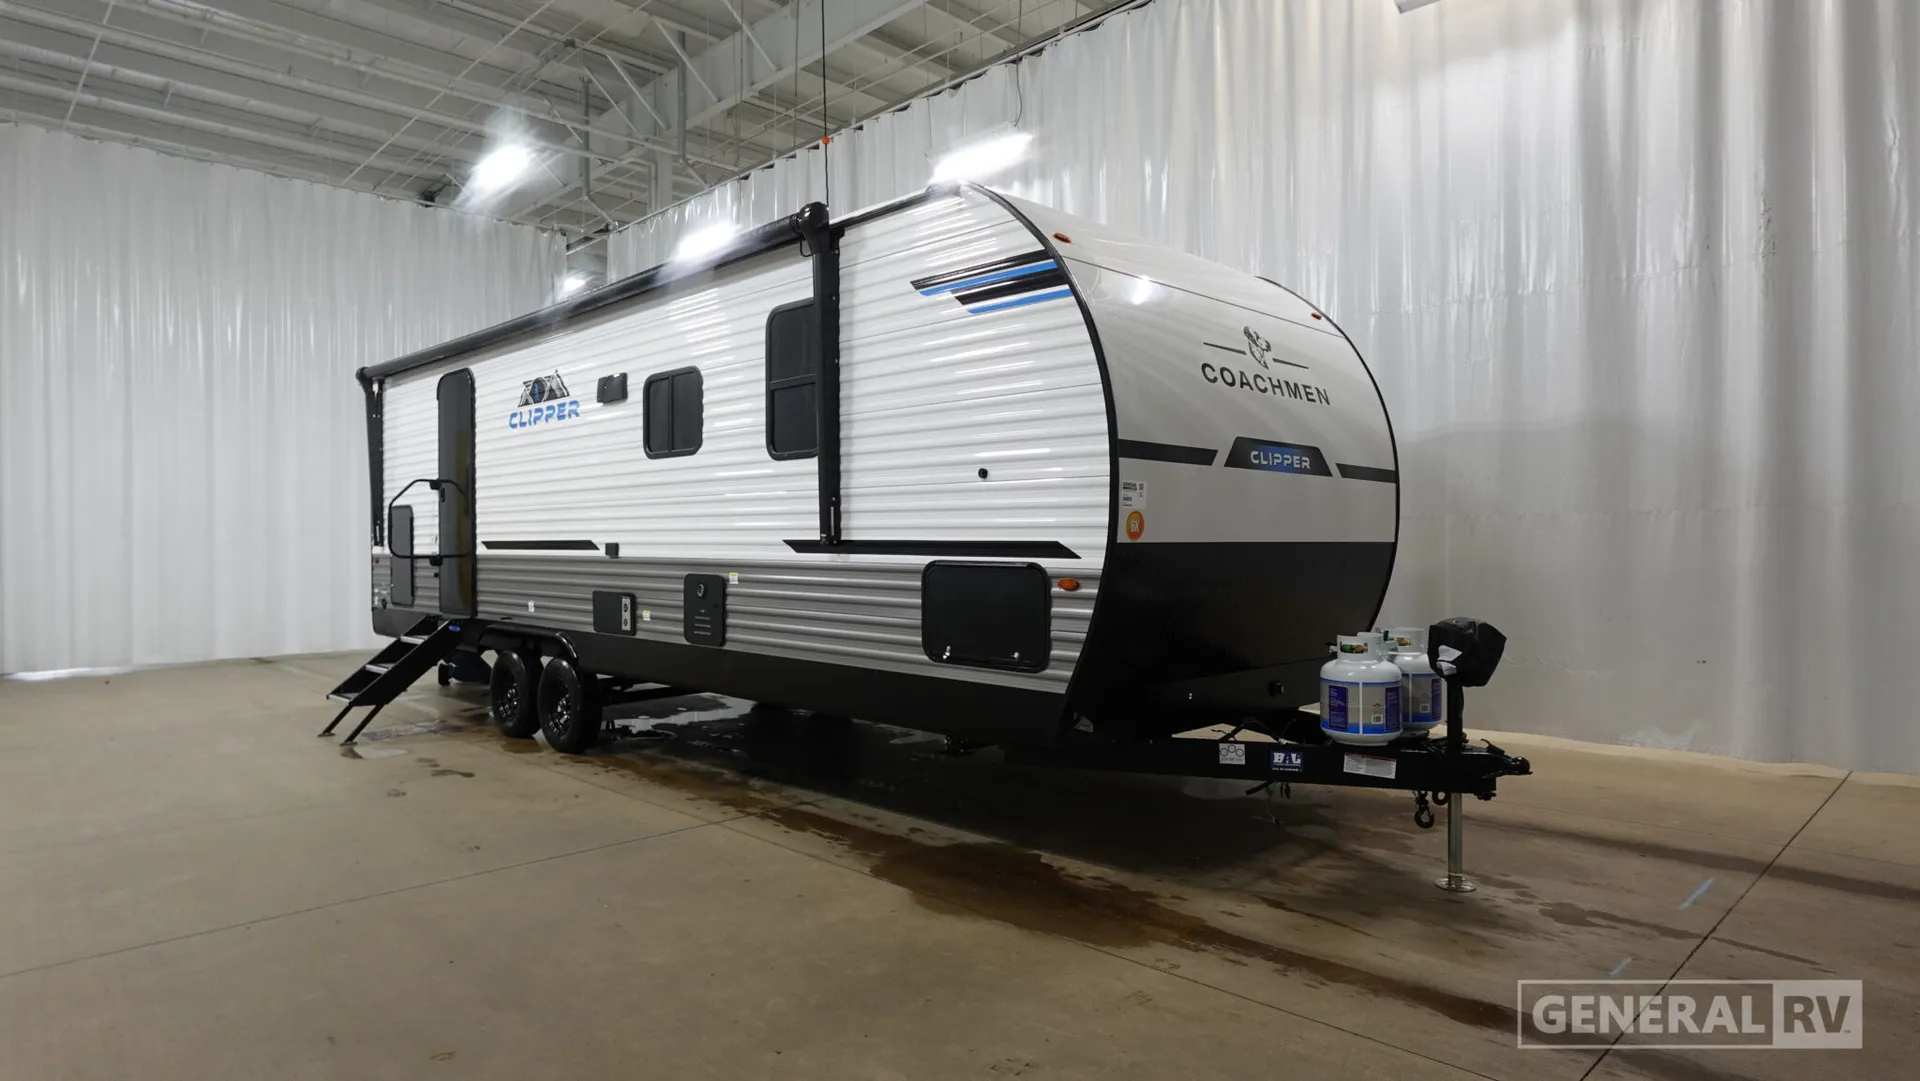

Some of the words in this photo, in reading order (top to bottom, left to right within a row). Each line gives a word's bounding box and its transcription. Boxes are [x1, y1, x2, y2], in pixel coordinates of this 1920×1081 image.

[1201, 362, 1331, 406] COACHMEN
[509, 400, 580, 429] CLIPPER
[1250, 450, 1312, 469] CLIPPER
